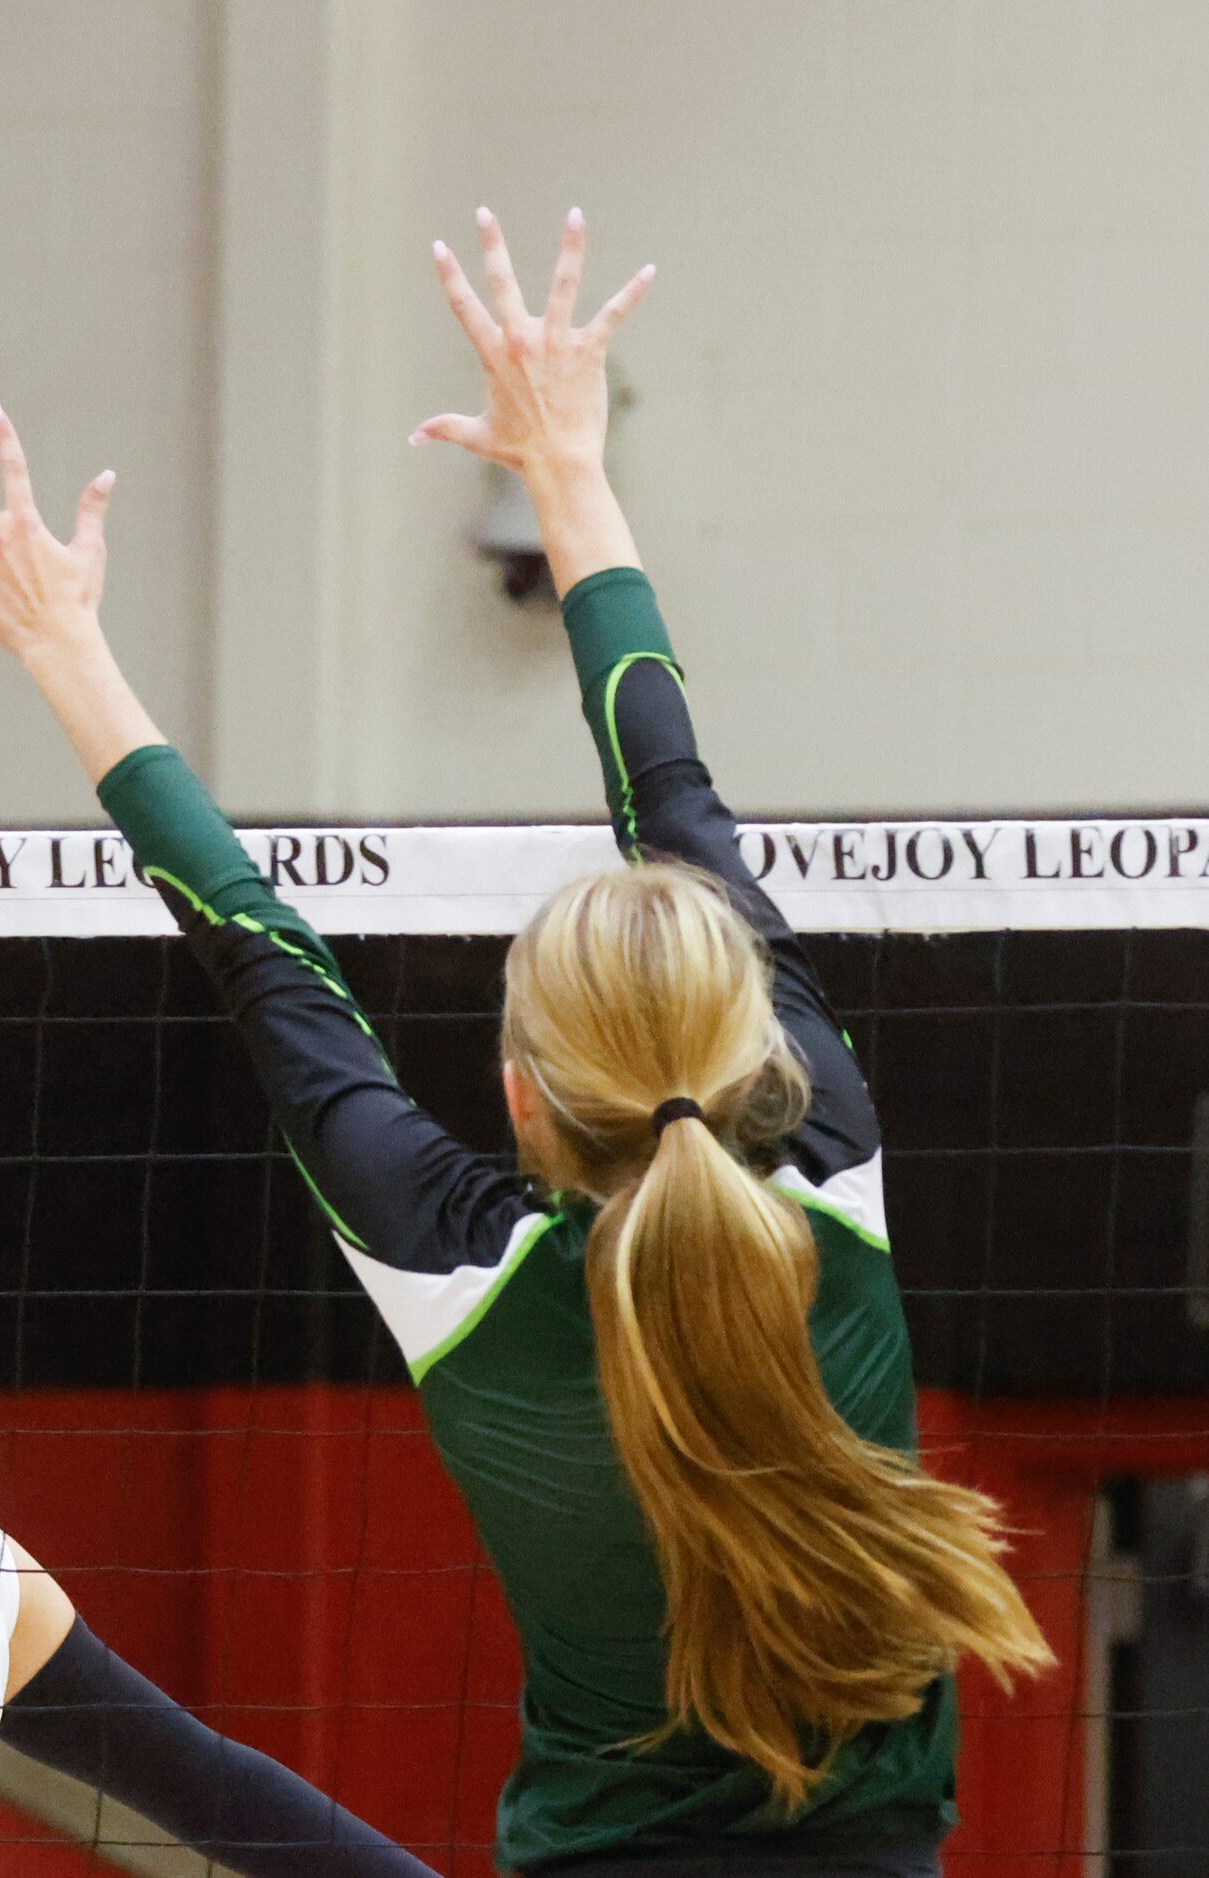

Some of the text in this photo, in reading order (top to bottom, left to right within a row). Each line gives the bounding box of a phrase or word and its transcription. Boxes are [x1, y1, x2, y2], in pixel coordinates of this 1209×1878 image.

[46, 833, 391, 889] LERDS
[738, 824, 1209, 881] OVEJOY LEOP
